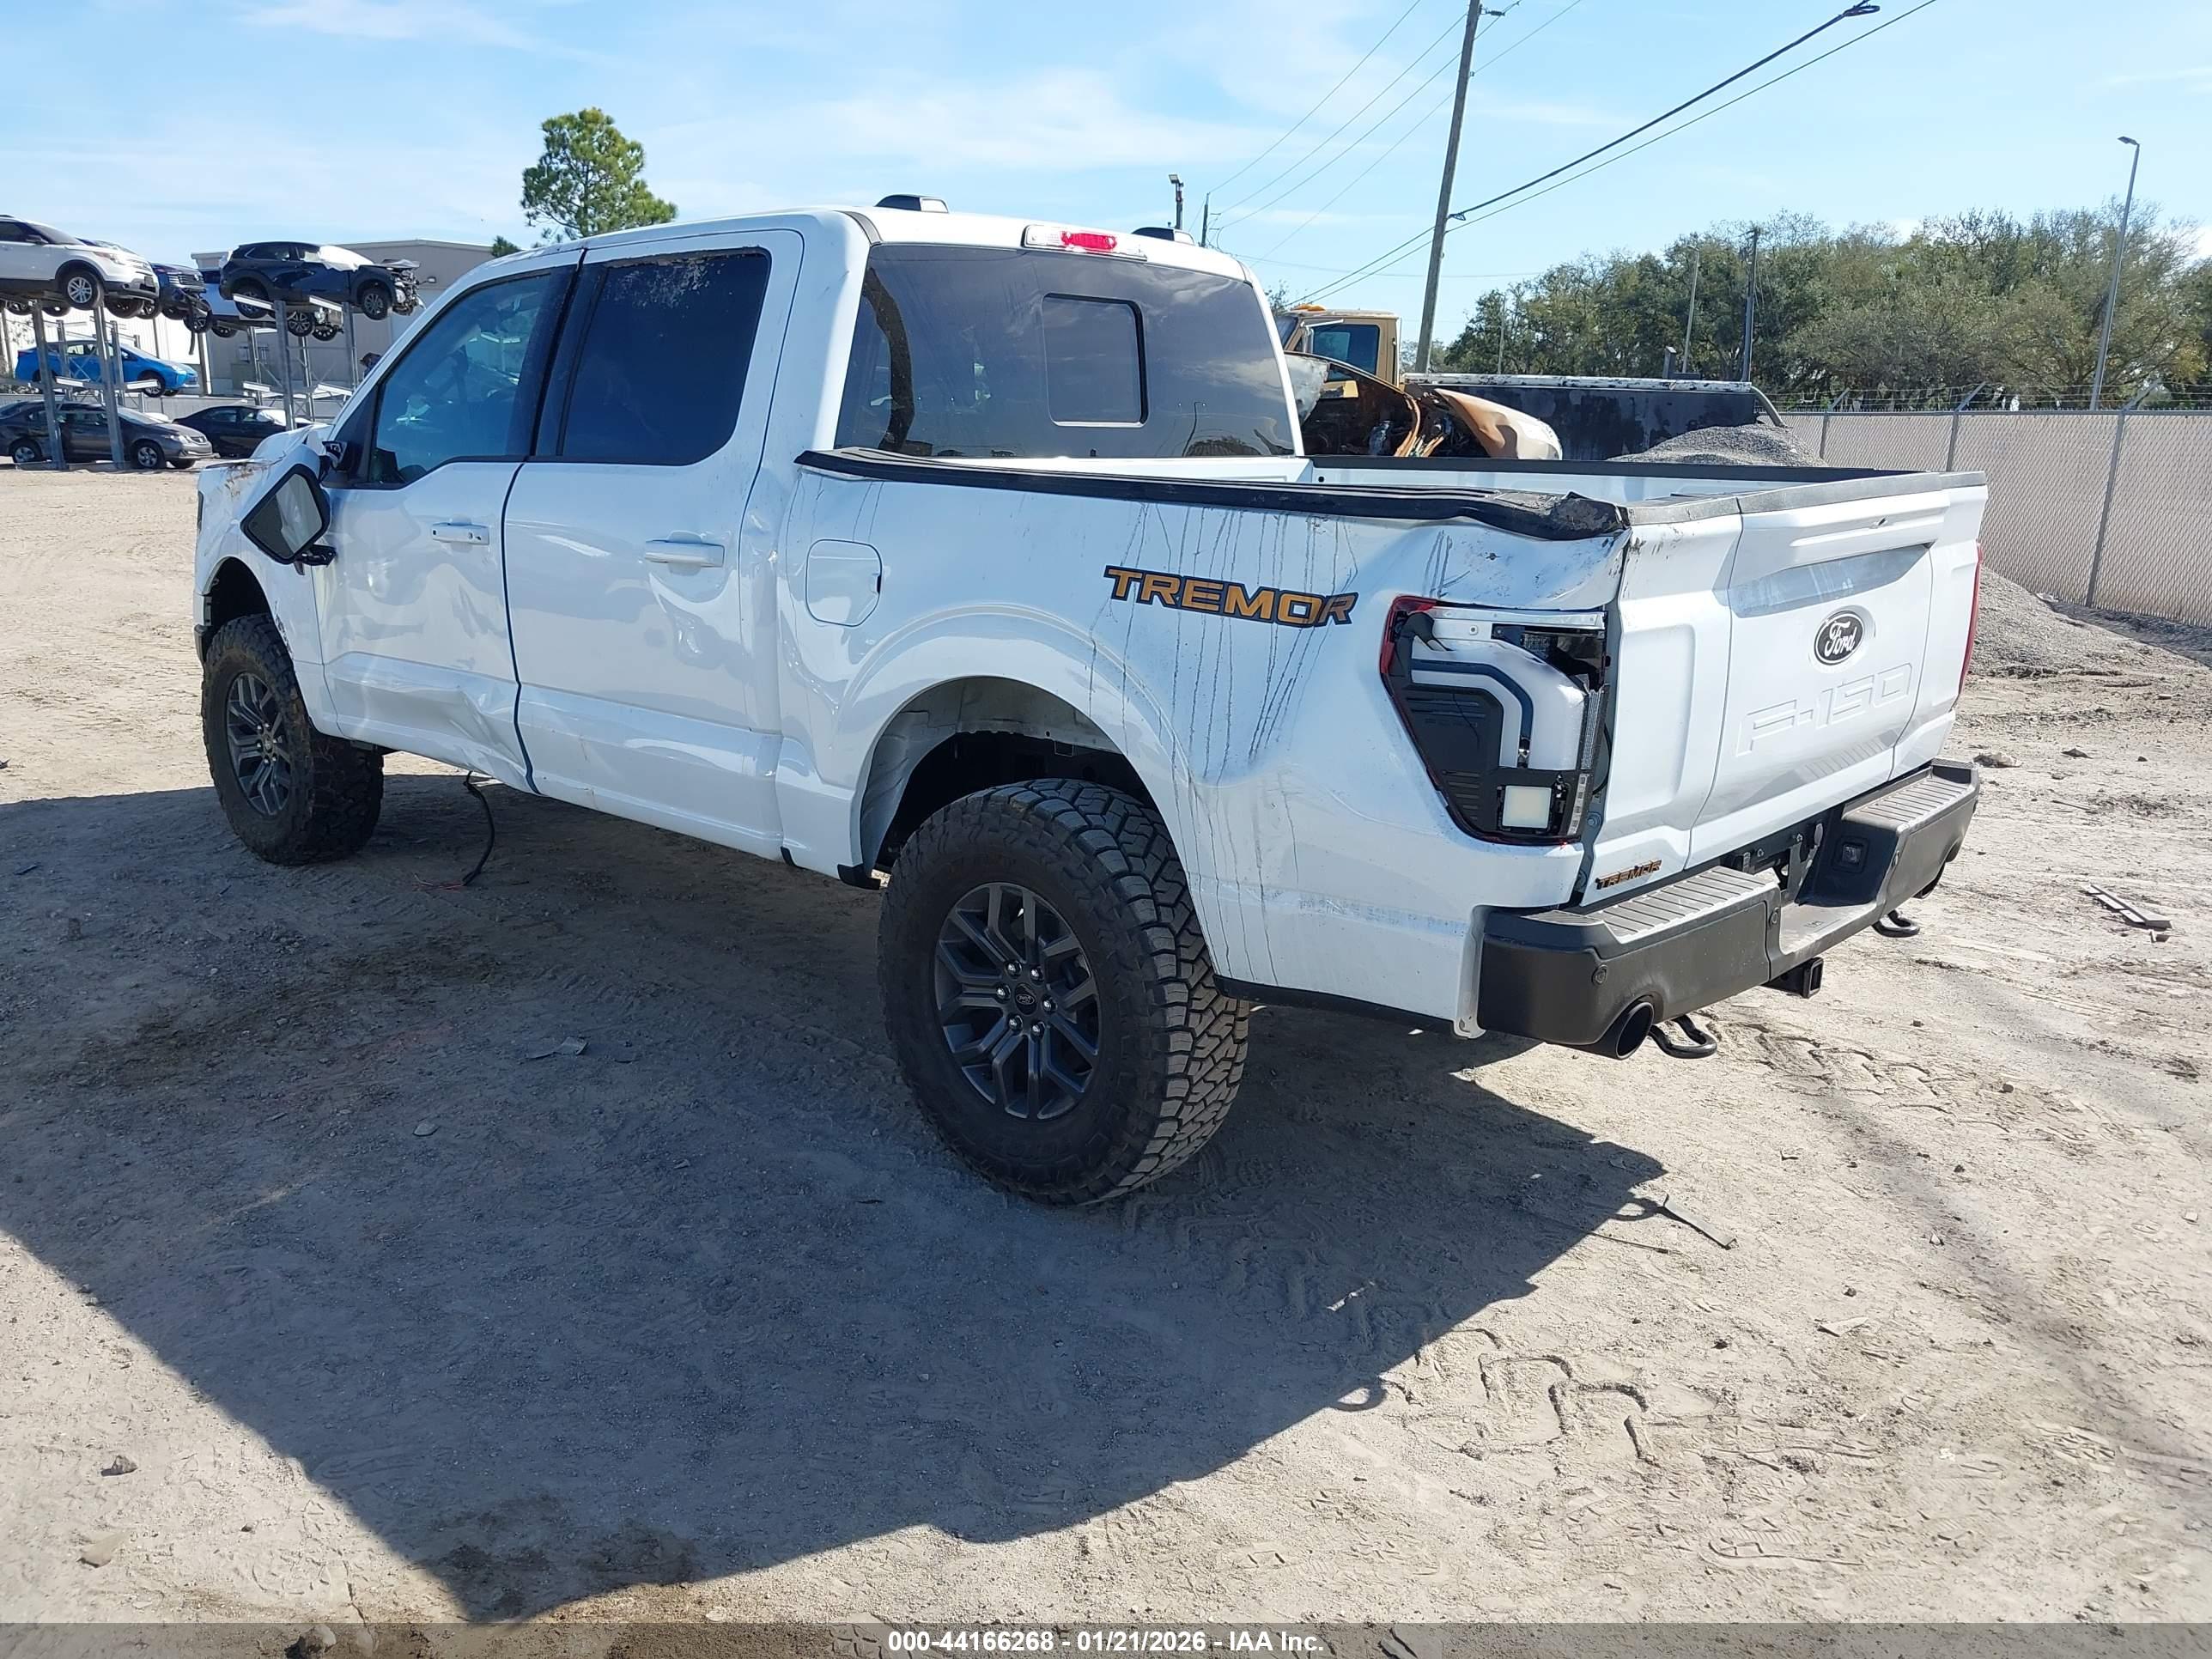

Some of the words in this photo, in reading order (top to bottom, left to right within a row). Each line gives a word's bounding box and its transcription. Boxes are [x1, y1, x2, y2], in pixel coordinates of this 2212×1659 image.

[1103, 565, 1358, 629] TREMOR
[1824, 620, 1857, 657] Ford
[1735, 662, 1913, 757] F-150
[1595, 860, 1662, 890] TREMOR
